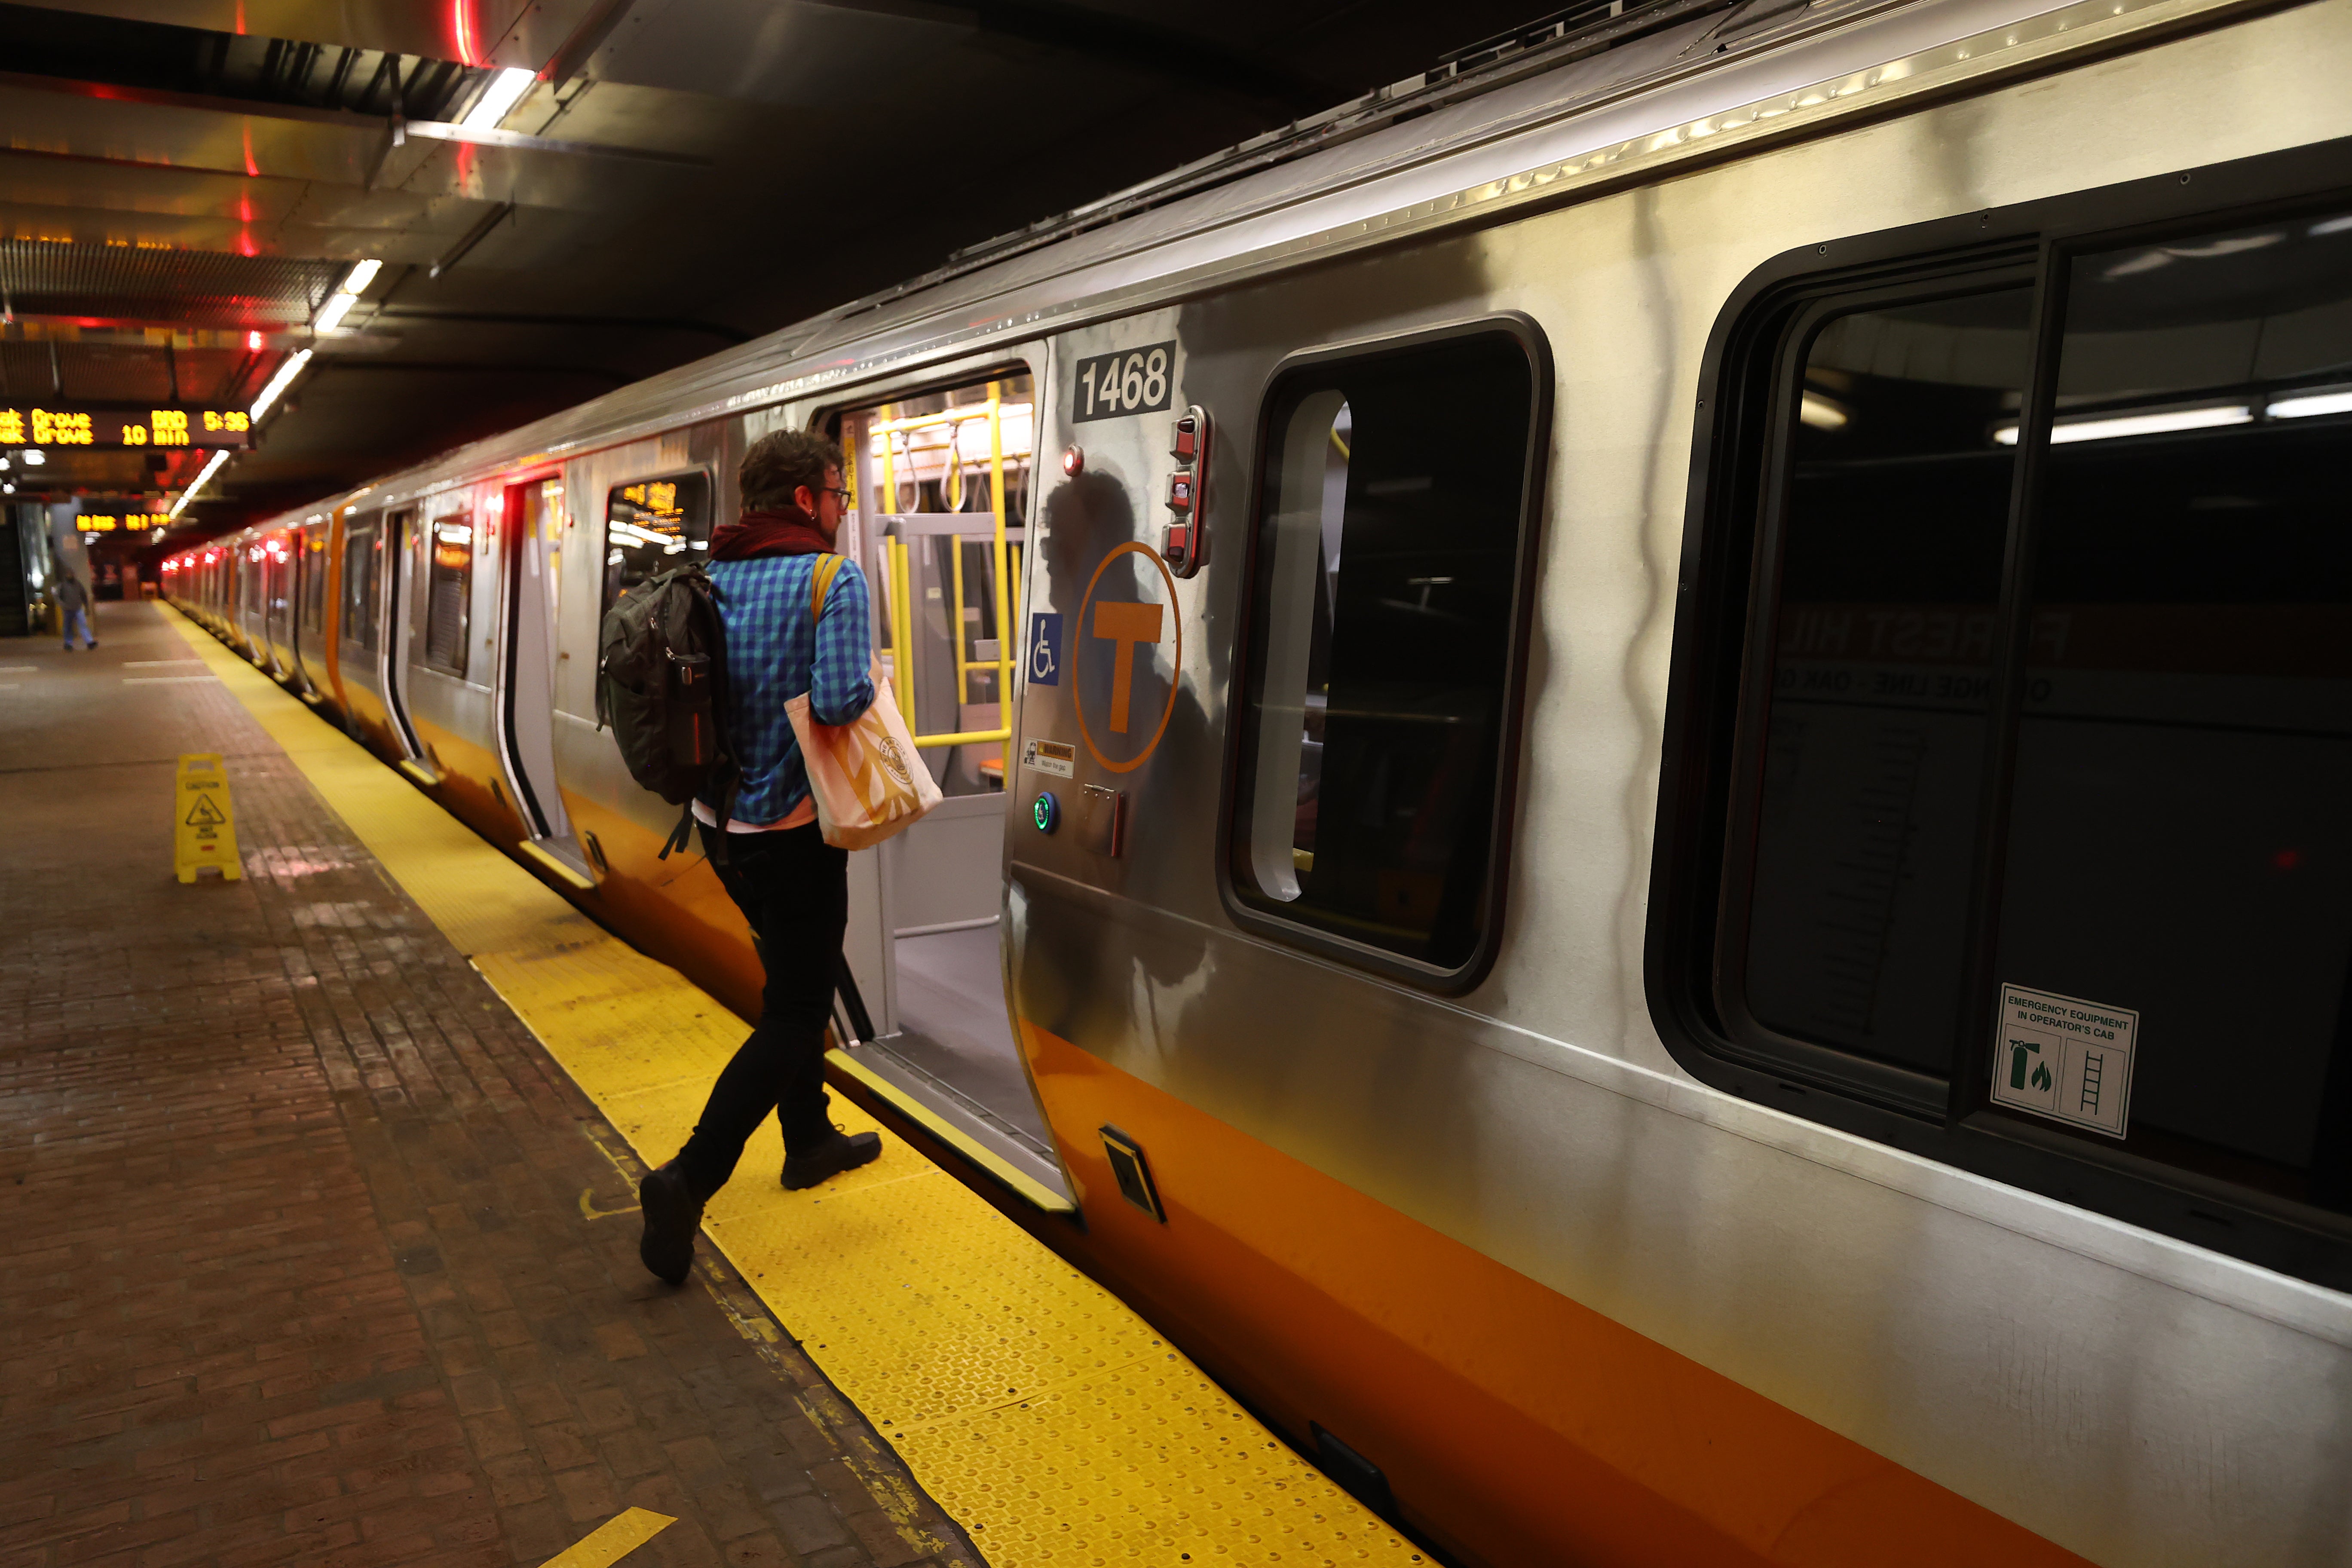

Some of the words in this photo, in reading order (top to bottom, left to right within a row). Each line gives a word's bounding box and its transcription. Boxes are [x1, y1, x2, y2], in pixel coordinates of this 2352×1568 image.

[1081, 348, 1167, 416] 1468
[32, 408, 92, 429] Grove
[151, 410, 187, 430] BRD
[34, 426, 94, 444] Grove
[122, 425, 147, 445] 10
[153, 429, 190, 445] min
[1093, 601, 1164, 733] T
[1044, 744, 1072, 758] WARNING
[2008, 995, 2067, 1016] EMERGENCY
[2070, 1010, 2129, 1030] EQUIPMENT
[2018, 1010, 2027, 1020] IN
[2029, 1013, 2091, 1035] OPERATOR'S
[2093, 1028, 2115, 1041] CAB
